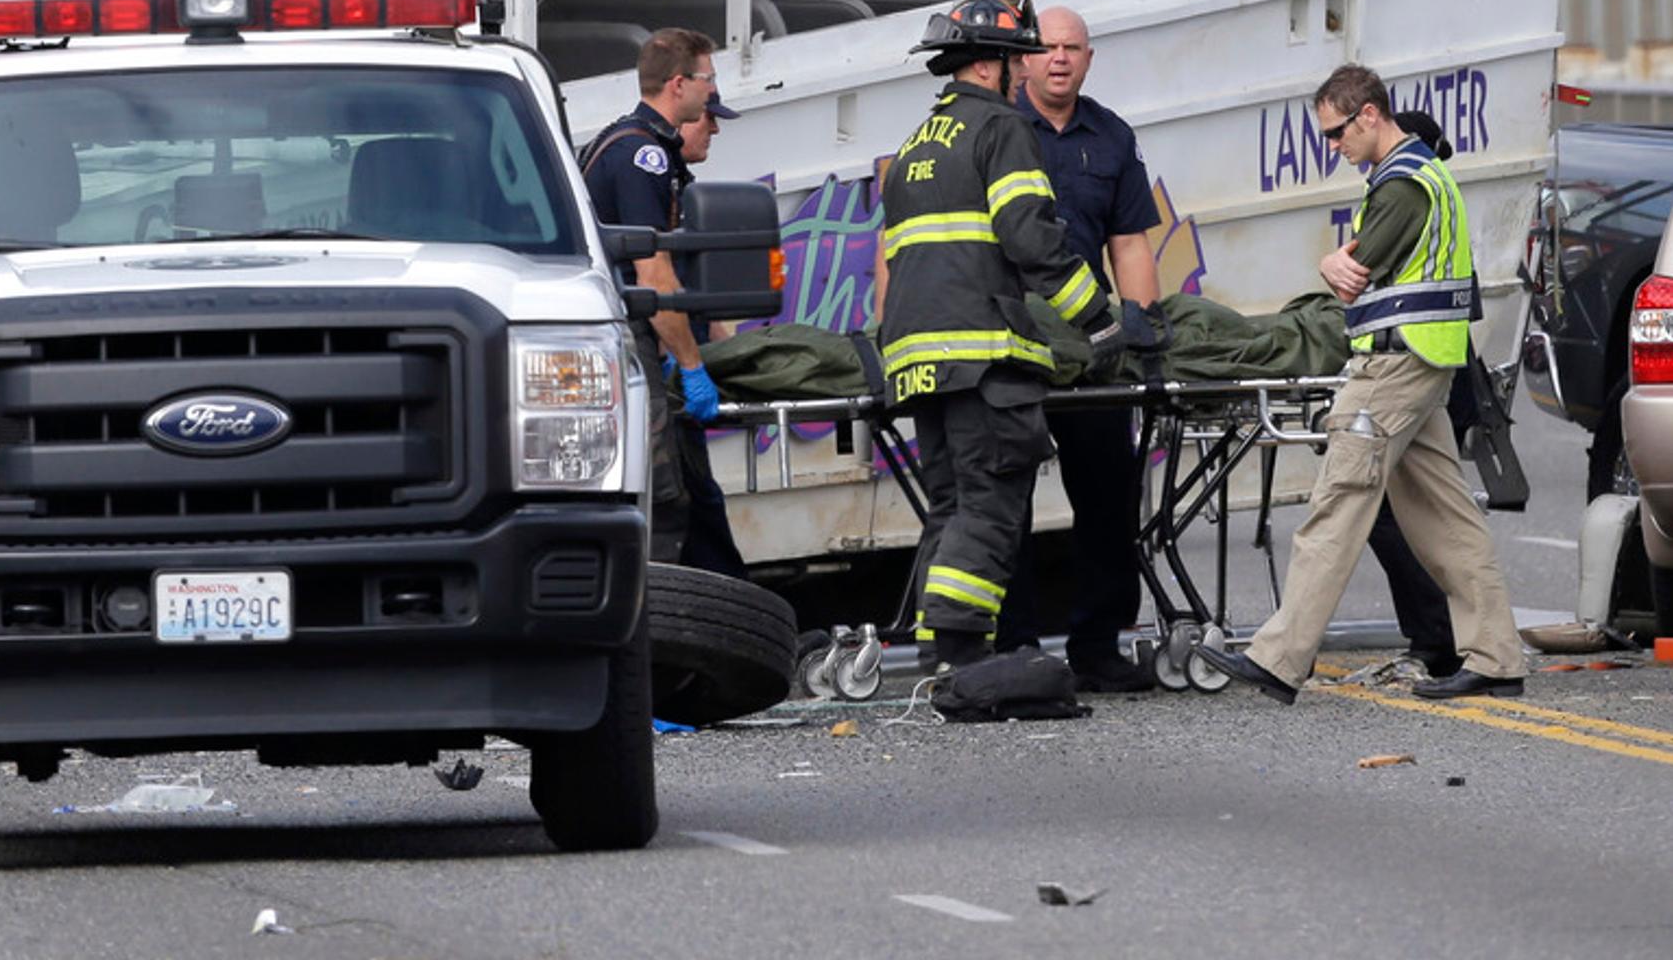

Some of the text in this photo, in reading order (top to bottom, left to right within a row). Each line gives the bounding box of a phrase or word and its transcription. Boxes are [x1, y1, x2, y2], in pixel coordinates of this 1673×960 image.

[906, 158, 936, 182] FIRE
[180, 404, 256, 437] Ford
[182, 597, 281, 628] A1929C
